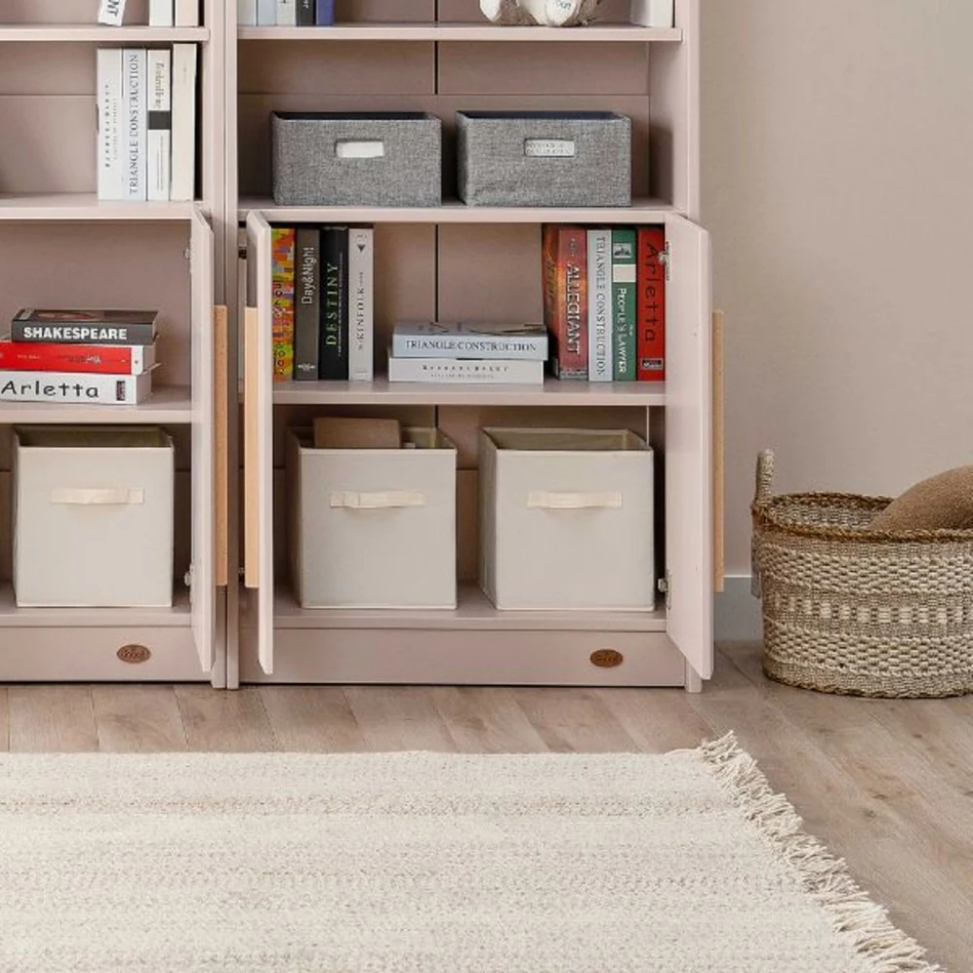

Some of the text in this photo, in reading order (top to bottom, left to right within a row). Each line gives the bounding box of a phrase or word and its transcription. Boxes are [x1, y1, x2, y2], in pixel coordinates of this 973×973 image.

[129, 54, 139, 194] TRIANGLE CONSTRUCTION
[301, 247, 317, 304] Day&Night
[326, 262, 338, 346] DESTINY
[644, 243, 661, 342] Arletta
[23, 327, 127, 340] SHAKESPEARE
[357, 287, 365, 340] KINFOLK
[567, 264, 580, 354] ALLEGIANT
[596, 237, 605, 376] TRIANGLE CONSTRUCTION
[406, 339, 536, 352] TRIANGLE CONSTRUCTION
[618, 334, 627, 374] LAWYER
[1, 380, 99, 398] Arletta
